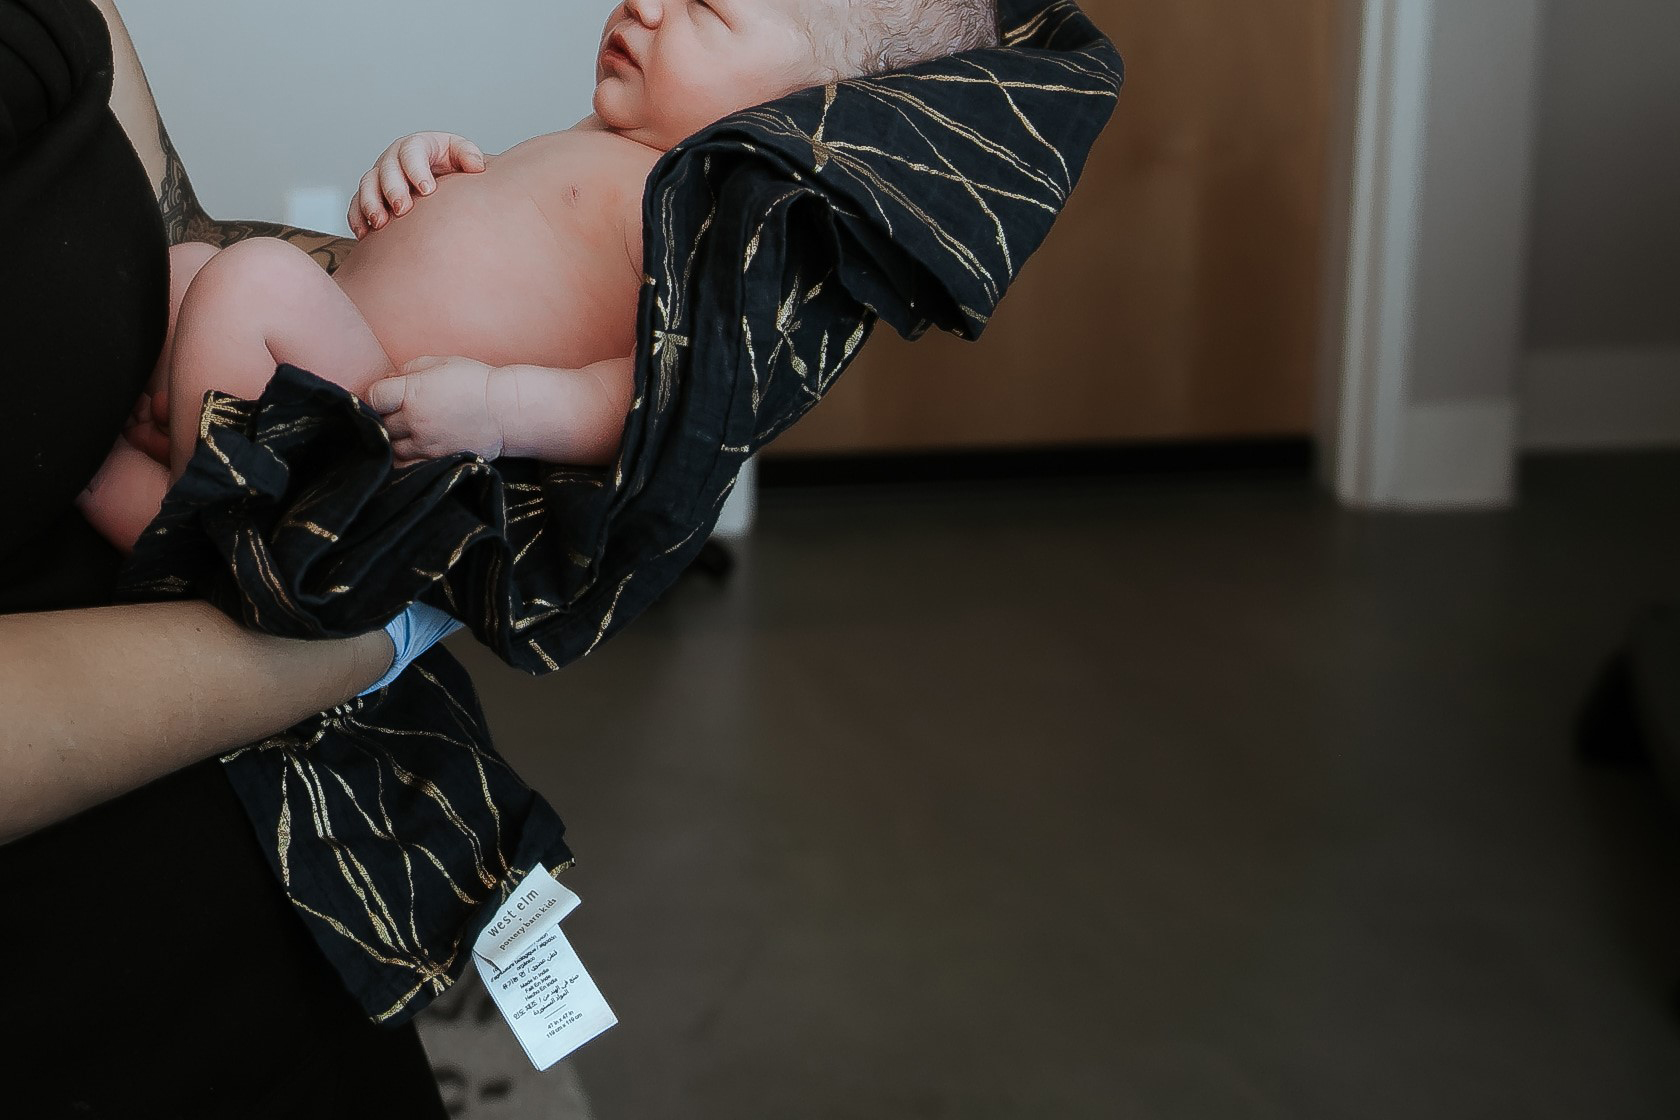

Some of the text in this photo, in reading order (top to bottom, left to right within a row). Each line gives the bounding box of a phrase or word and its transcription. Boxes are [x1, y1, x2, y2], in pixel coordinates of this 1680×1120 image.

[488, 889, 539, 937] west elm
[499, 927, 526, 951] pottery
[523, 913, 541, 927] barn
[538, 898, 557, 913] kids
[520, 978, 533, 989] Made
[538, 968, 549, 977] India
[565, 1017, 575, 1025] 119
